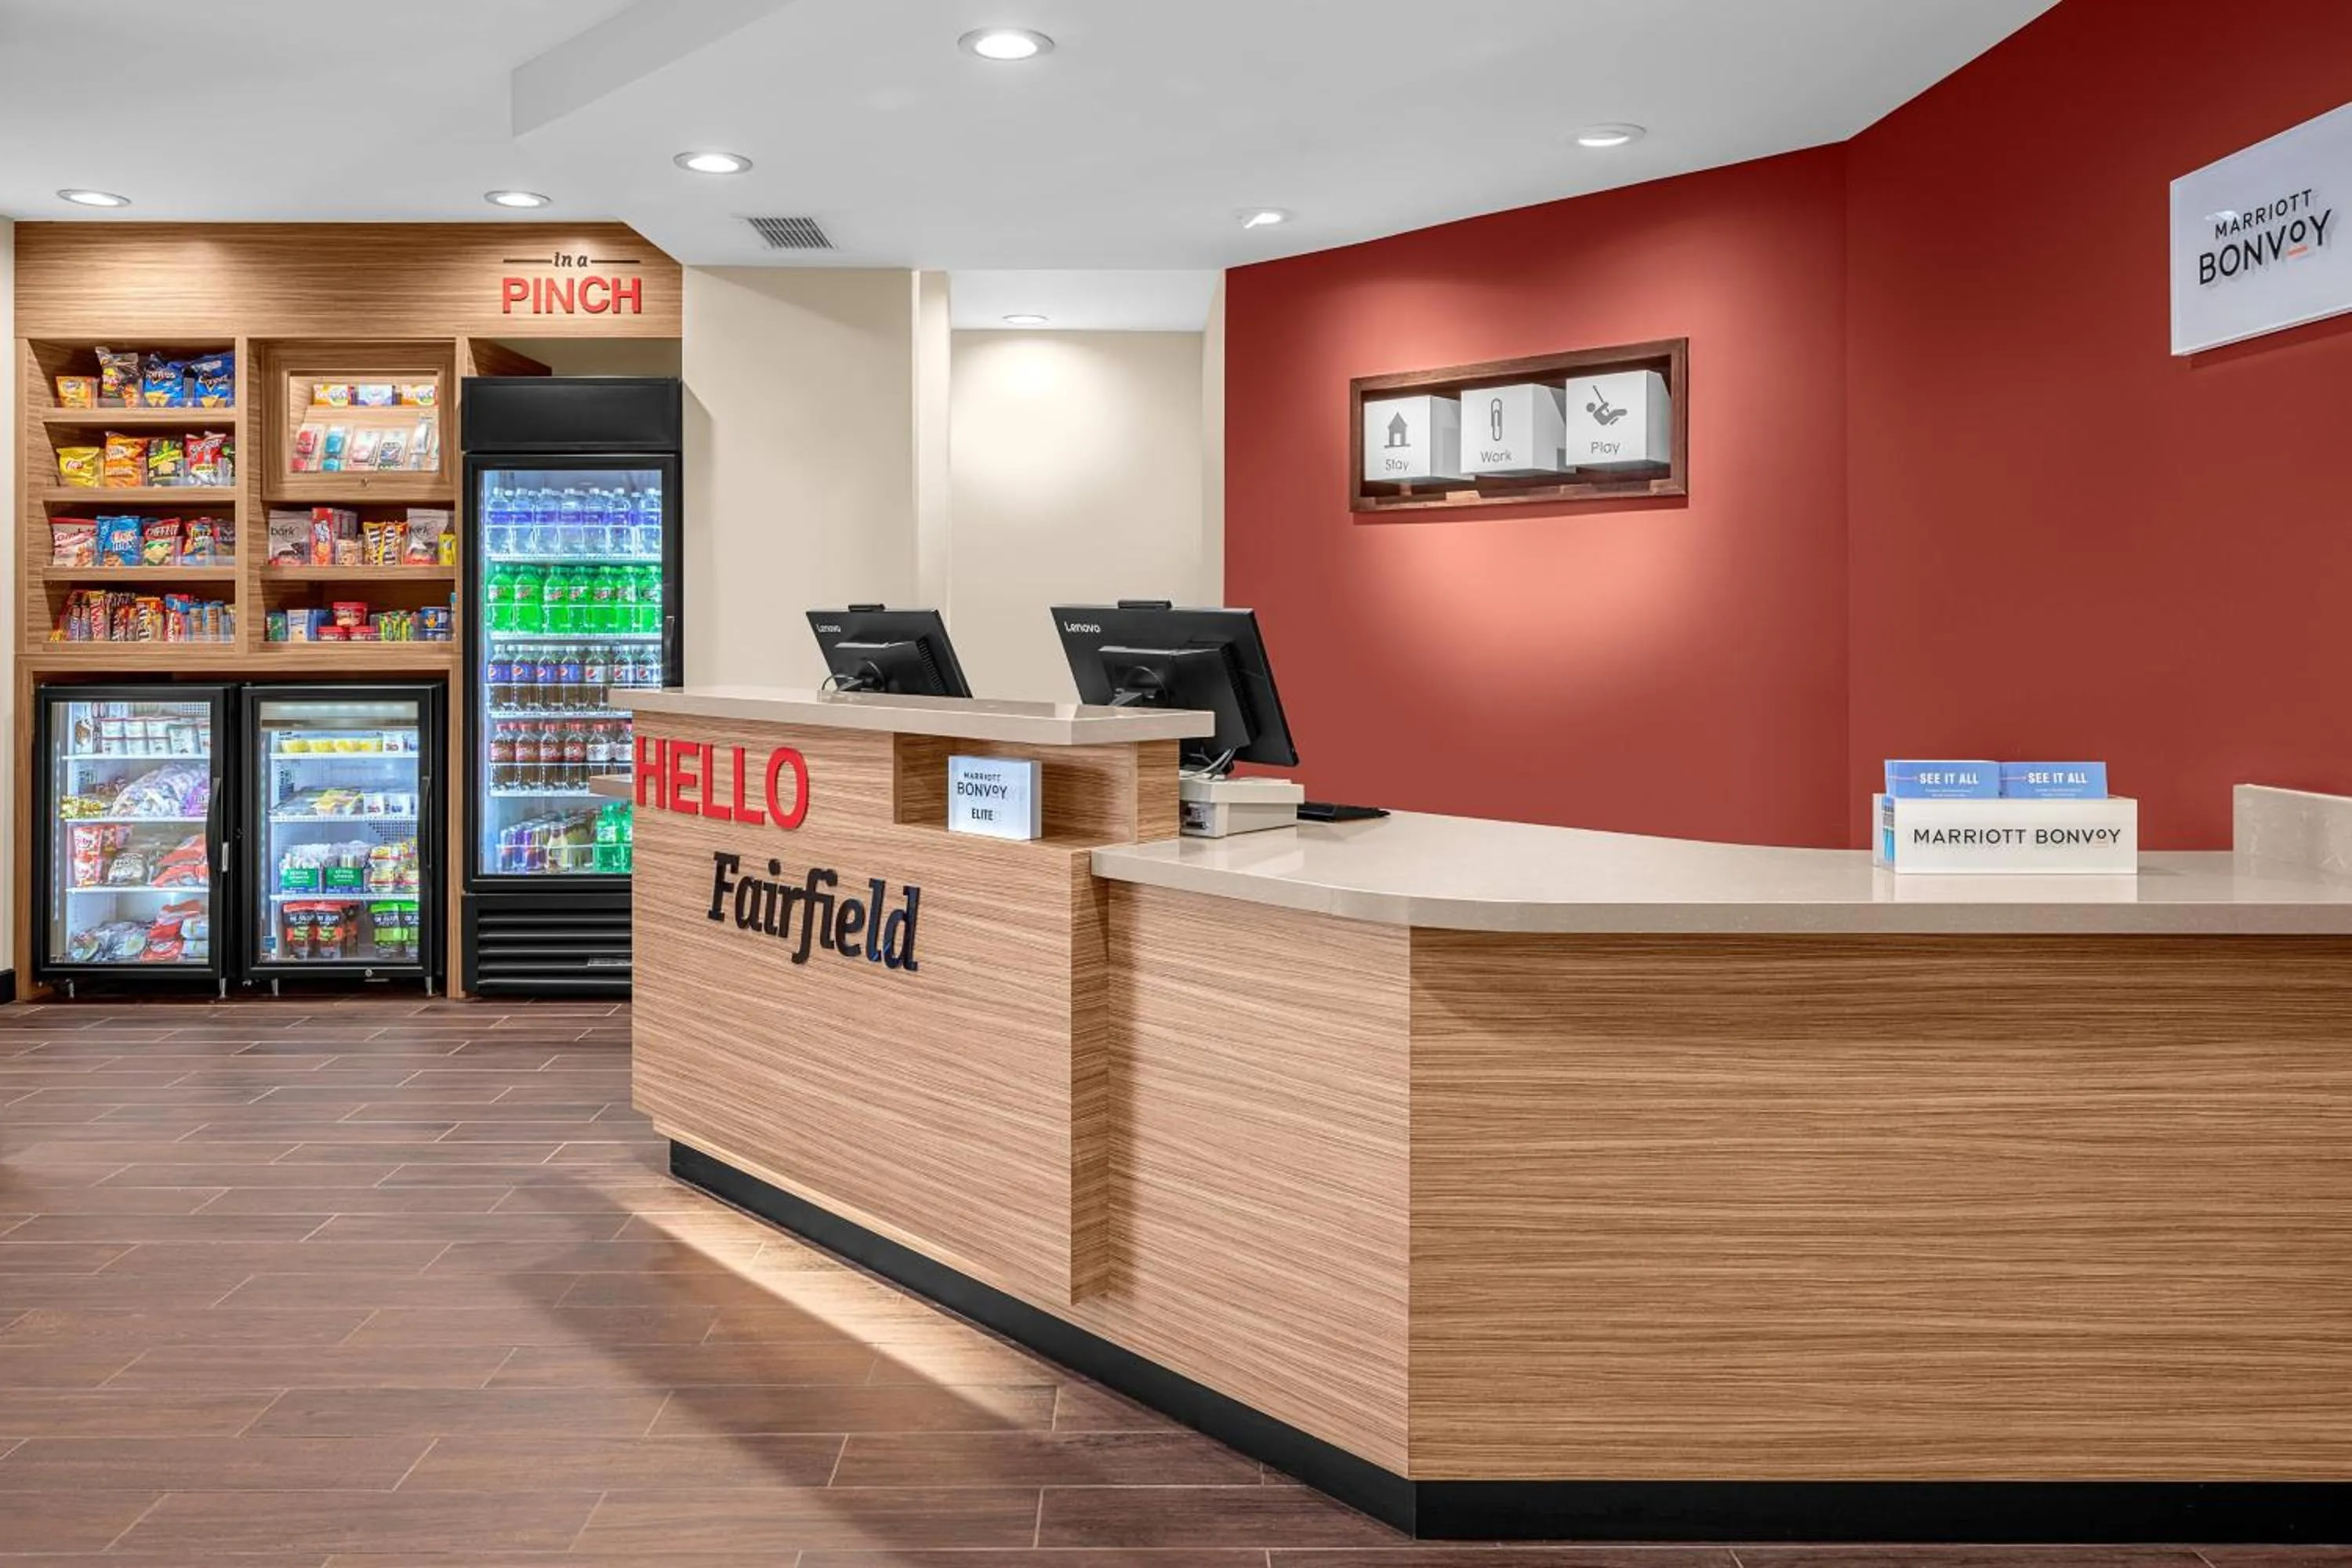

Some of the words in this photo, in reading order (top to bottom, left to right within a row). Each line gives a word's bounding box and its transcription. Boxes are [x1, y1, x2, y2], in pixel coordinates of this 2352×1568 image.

[2215, 188, 2312, 239] MARRIOTT
[2198, 209, 2332, 285] BONVOY
[554, 252, 572, 267] in
[577, 255, 588, 267] a
[503, 276, 642, 314] PINCH
[1591, 441, 1621, 456] Play
[1480, 450, 1512, 463] Work
[1385, 458, 1410, 471] Stay
[816, 623, 841, 633] Lenovo
[1064, 620, 1102, 633] Lenovo
[636, 735, 810, 830] HELLO
[964, 771, 1002, 782] MARRIOTT
[1919, 773, 1940, 785] SEE
[1944, 773, 1956, 785] IT
[1959, 773, 1980, 785] ALL
[2027, 772, 2049, 784] SEE
[2053, 772, 2064, 784] IT
[2067, 772, 2088, 784] ALL
[956, 782, 1008, 800] BONVOY
[971, 807, 994, 821] ELITE
[1913, 829, 2027, 844] MARRIOTT
[2035, 829, 2122, 844] BONVOY
[707, 851, 920, 972] Fairfield
